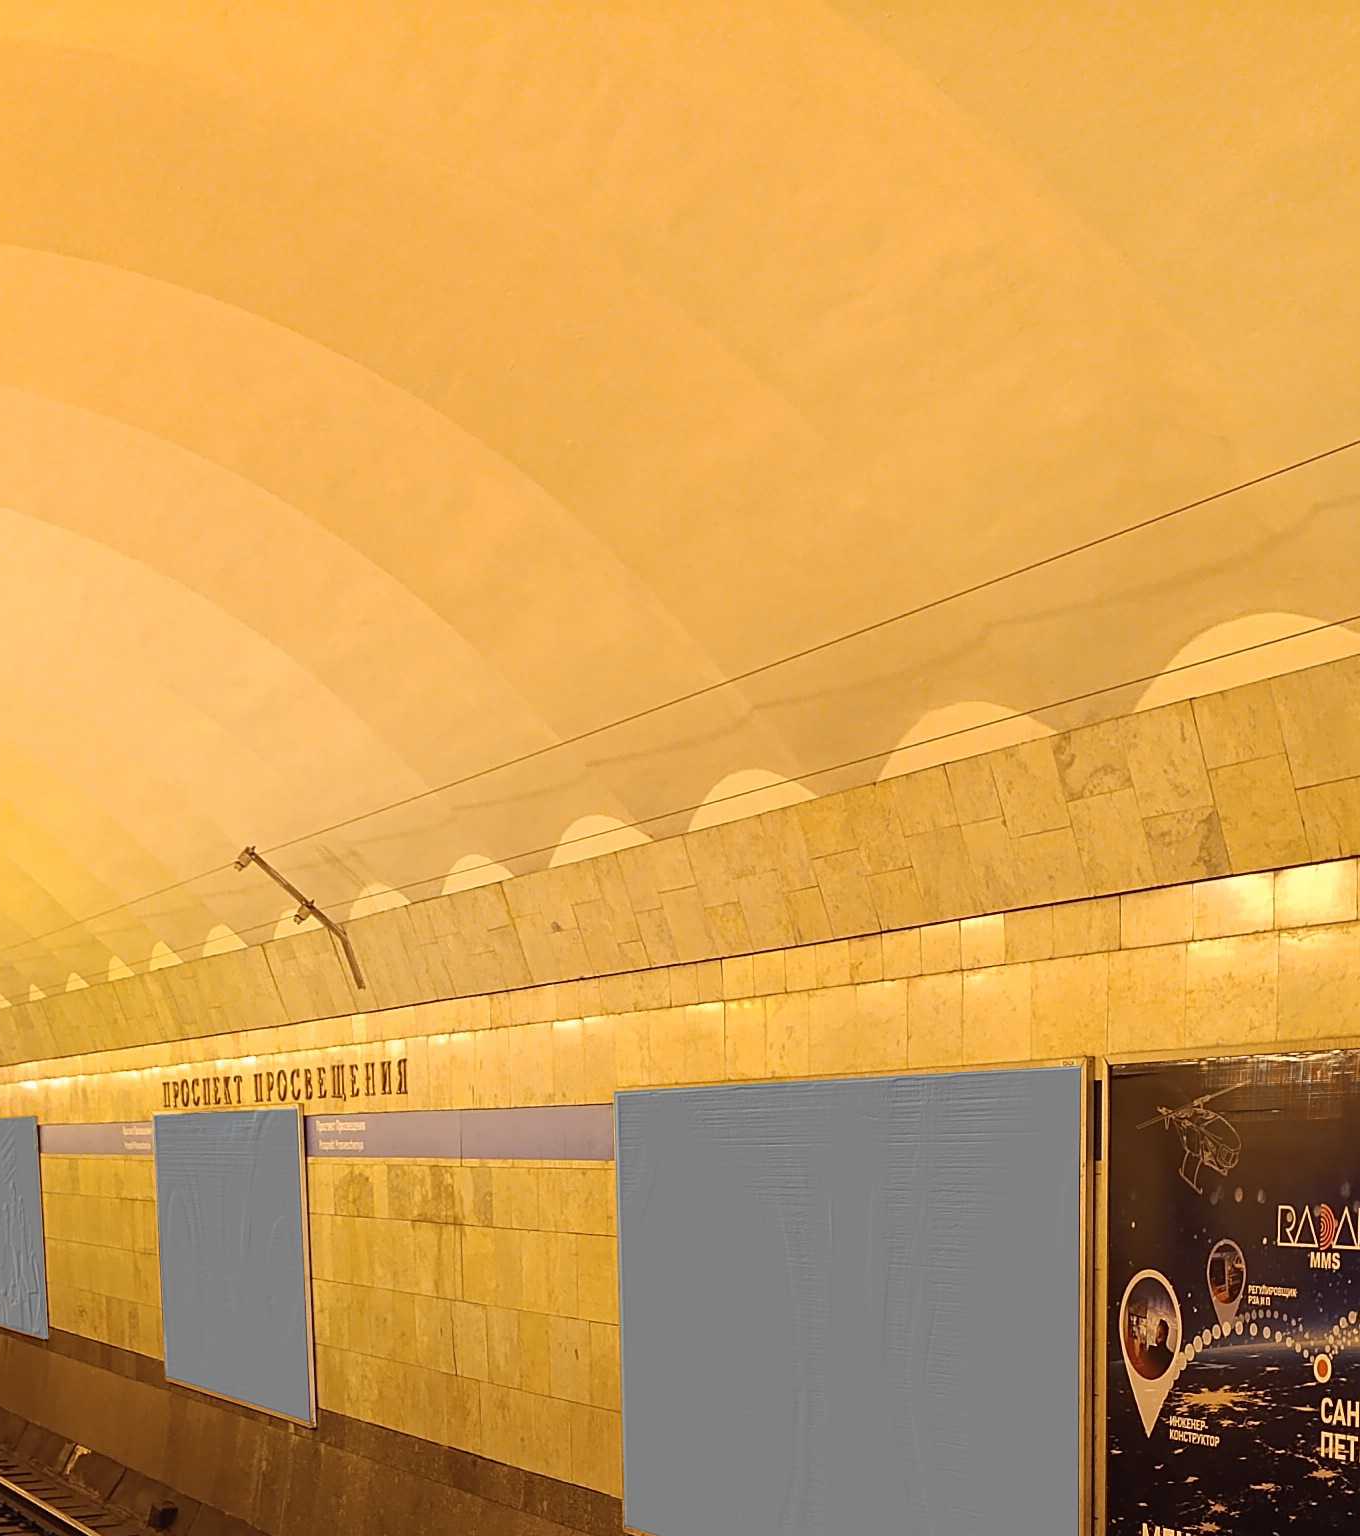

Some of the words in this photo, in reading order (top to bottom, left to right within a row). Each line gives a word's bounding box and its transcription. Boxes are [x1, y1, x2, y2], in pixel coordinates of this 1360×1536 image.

[162, 1075, 243, 1108] ПРОСПЕКТ
[254, 1058, 409, 1102] ПРОСВЕЩЕНИЯ
[1309, 1252, 1341, 1270] MMS
[1169, 1429, 1220, 1448] КОНСТРУКТОР
